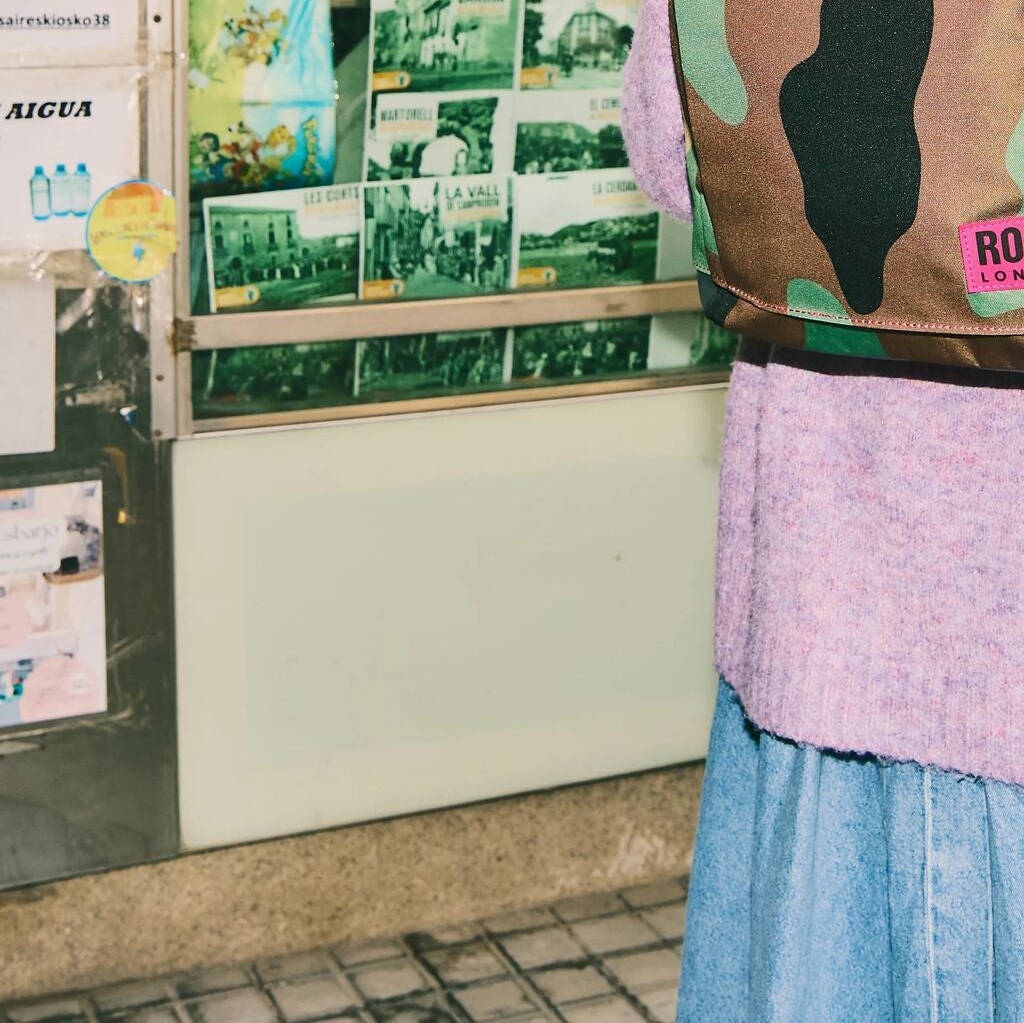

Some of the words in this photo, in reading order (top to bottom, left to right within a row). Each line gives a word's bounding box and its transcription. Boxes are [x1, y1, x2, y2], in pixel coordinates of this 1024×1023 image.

[5, 100, 93, 120] AIGUA
[446, 186, 462, 199] LA
[467, 184, 500, 197] VALL
